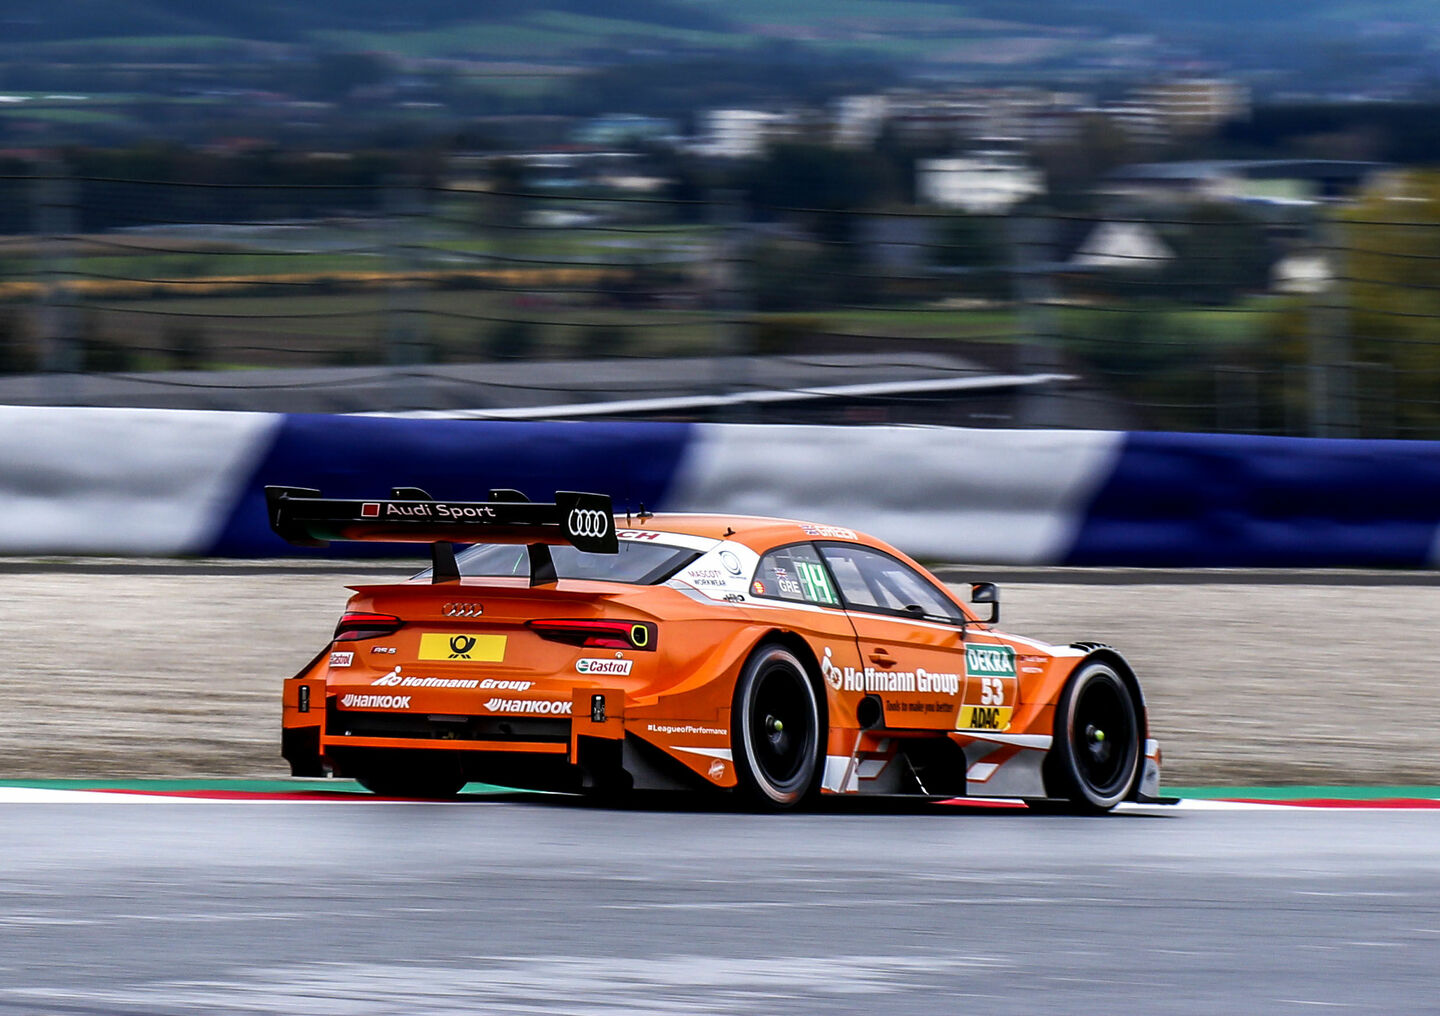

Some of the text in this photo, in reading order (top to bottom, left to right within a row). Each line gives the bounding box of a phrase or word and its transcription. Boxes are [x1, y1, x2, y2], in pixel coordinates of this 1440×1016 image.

[386, 503, 497, 520] Audi Sport
[778, 579, 801, 595] GRE
[799, 561, 834, 604] 14
[589, 660, 629, 675] Castrol
[967, 649, 1014, 673] DEKRA
[400, 675, 531, 692] Hoffmann Group
[843, 666, 960, 696] Hoffmann Group
[980, 677, 1005, 706] 53
[901, 701, 908, 712] to
[970, 707, 1001, 729] ADAC
[647, 724, 728, 735] #LeagueofPerformance
